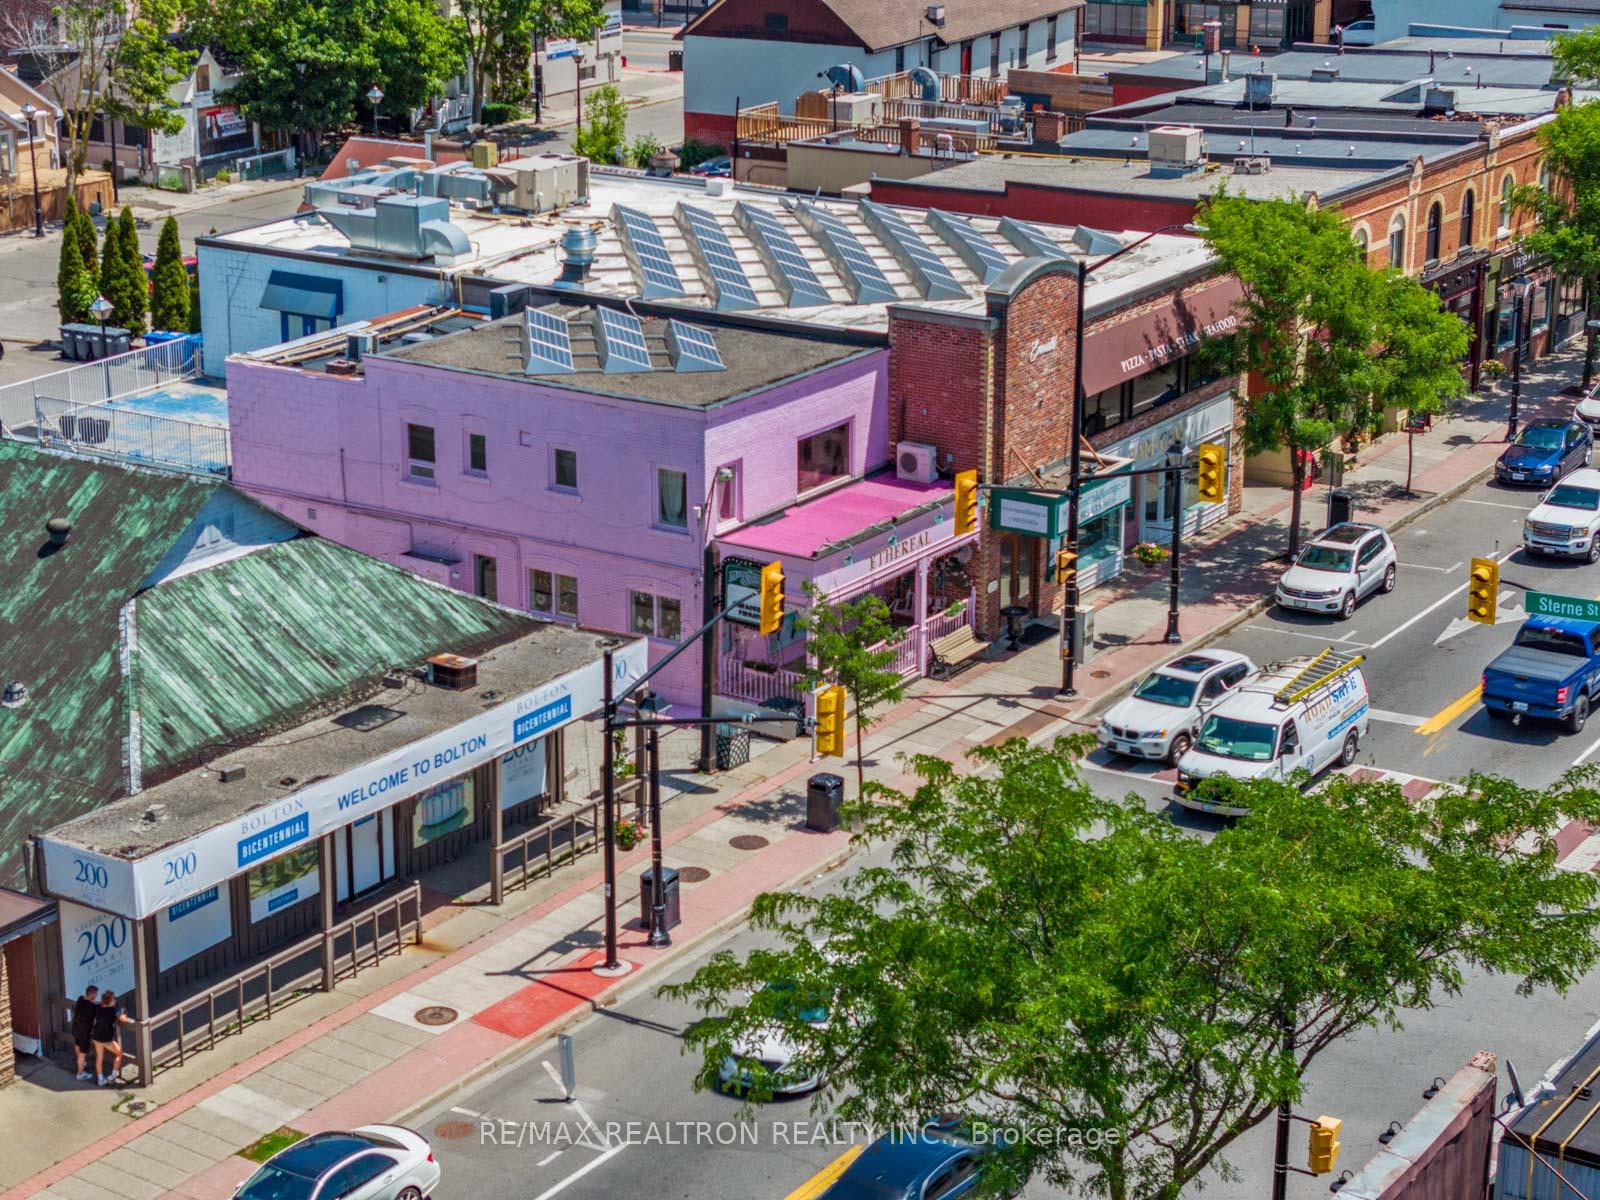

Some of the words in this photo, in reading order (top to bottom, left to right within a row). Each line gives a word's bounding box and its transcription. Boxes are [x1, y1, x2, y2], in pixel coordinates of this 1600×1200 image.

[1120, 354, 1145, 373] PIZZA
[1148, 343, 1172, 361] PASTA
[1175, 330, 1200, 350] STEAK
[1203, 315, 1237, 337] SEAFOOD
[869, 528, 929, 571] ETHEREAL
[1539, 597, 1583, 616] Sterne
[1587, 603, 1599, 616] St
[516, 682, 569, 714] BOLTON
[516, 703, 569, 736] BICENTENNIAL
[337, 768, 409, 811] WELCOME
[412, 759, 430, 777] TO
[434, 733, 487, 769] BOLTON
[241, 798, 304, 835] BOLTON
[241, 820, 306, 859] BICENTENNIAL
[73, 859, 108, 889] 200
[164, 851, 197, 885] 200
[77, 917, 126, 967] 200
